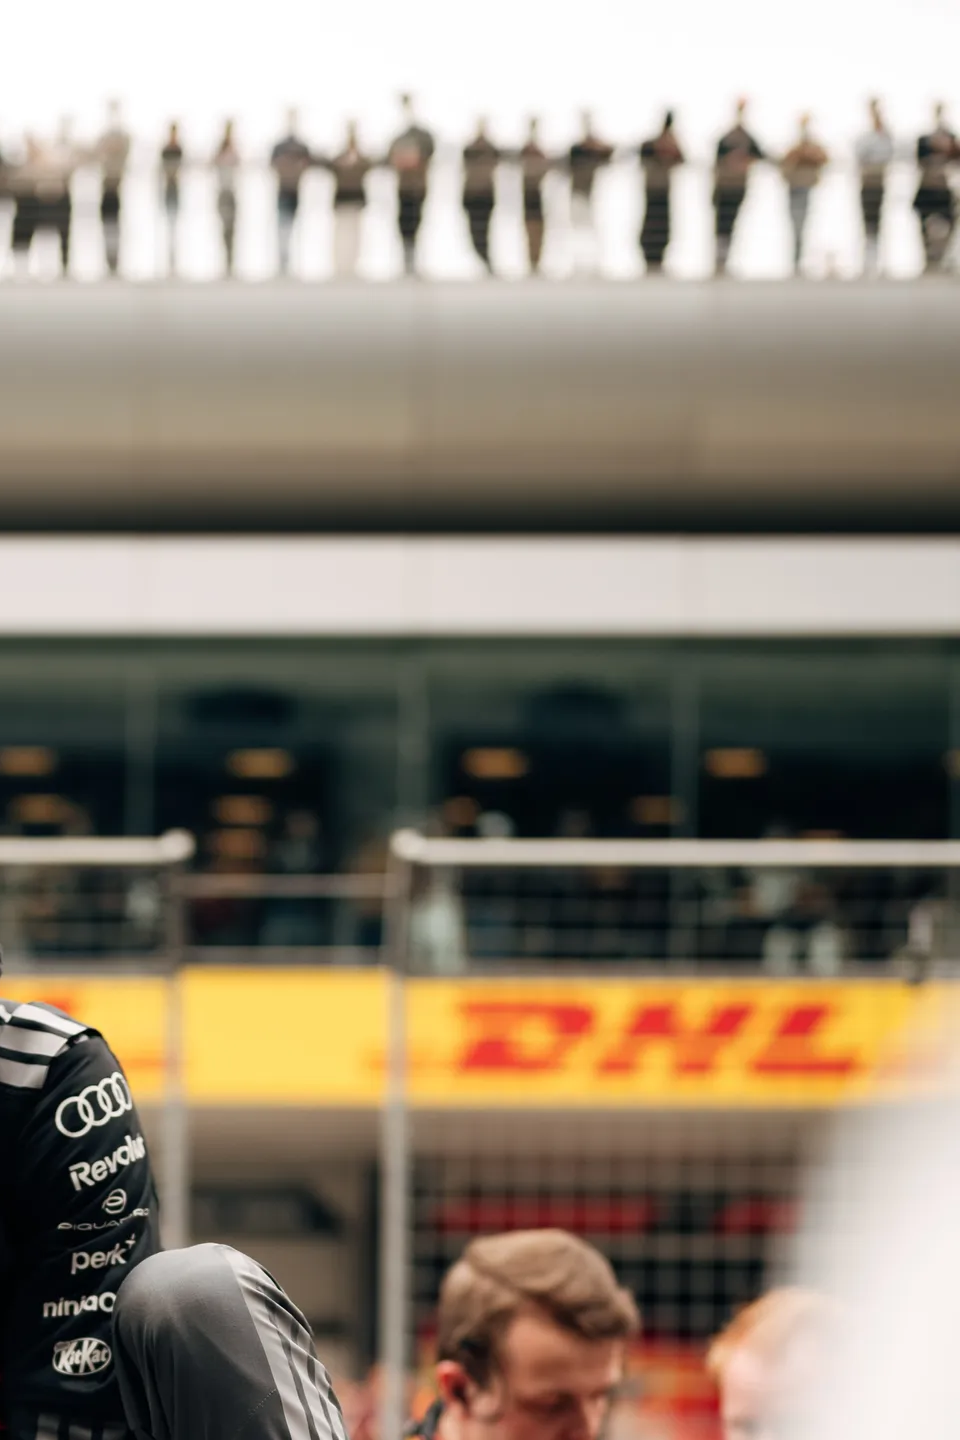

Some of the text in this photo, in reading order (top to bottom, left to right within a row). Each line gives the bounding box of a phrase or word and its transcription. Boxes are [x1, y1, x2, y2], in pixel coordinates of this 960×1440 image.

[454, 1000, 858, 1076] DHL
[68, 1132, 147, 1192] Revolut
[56, 1338, 109, 1375] KitKat
